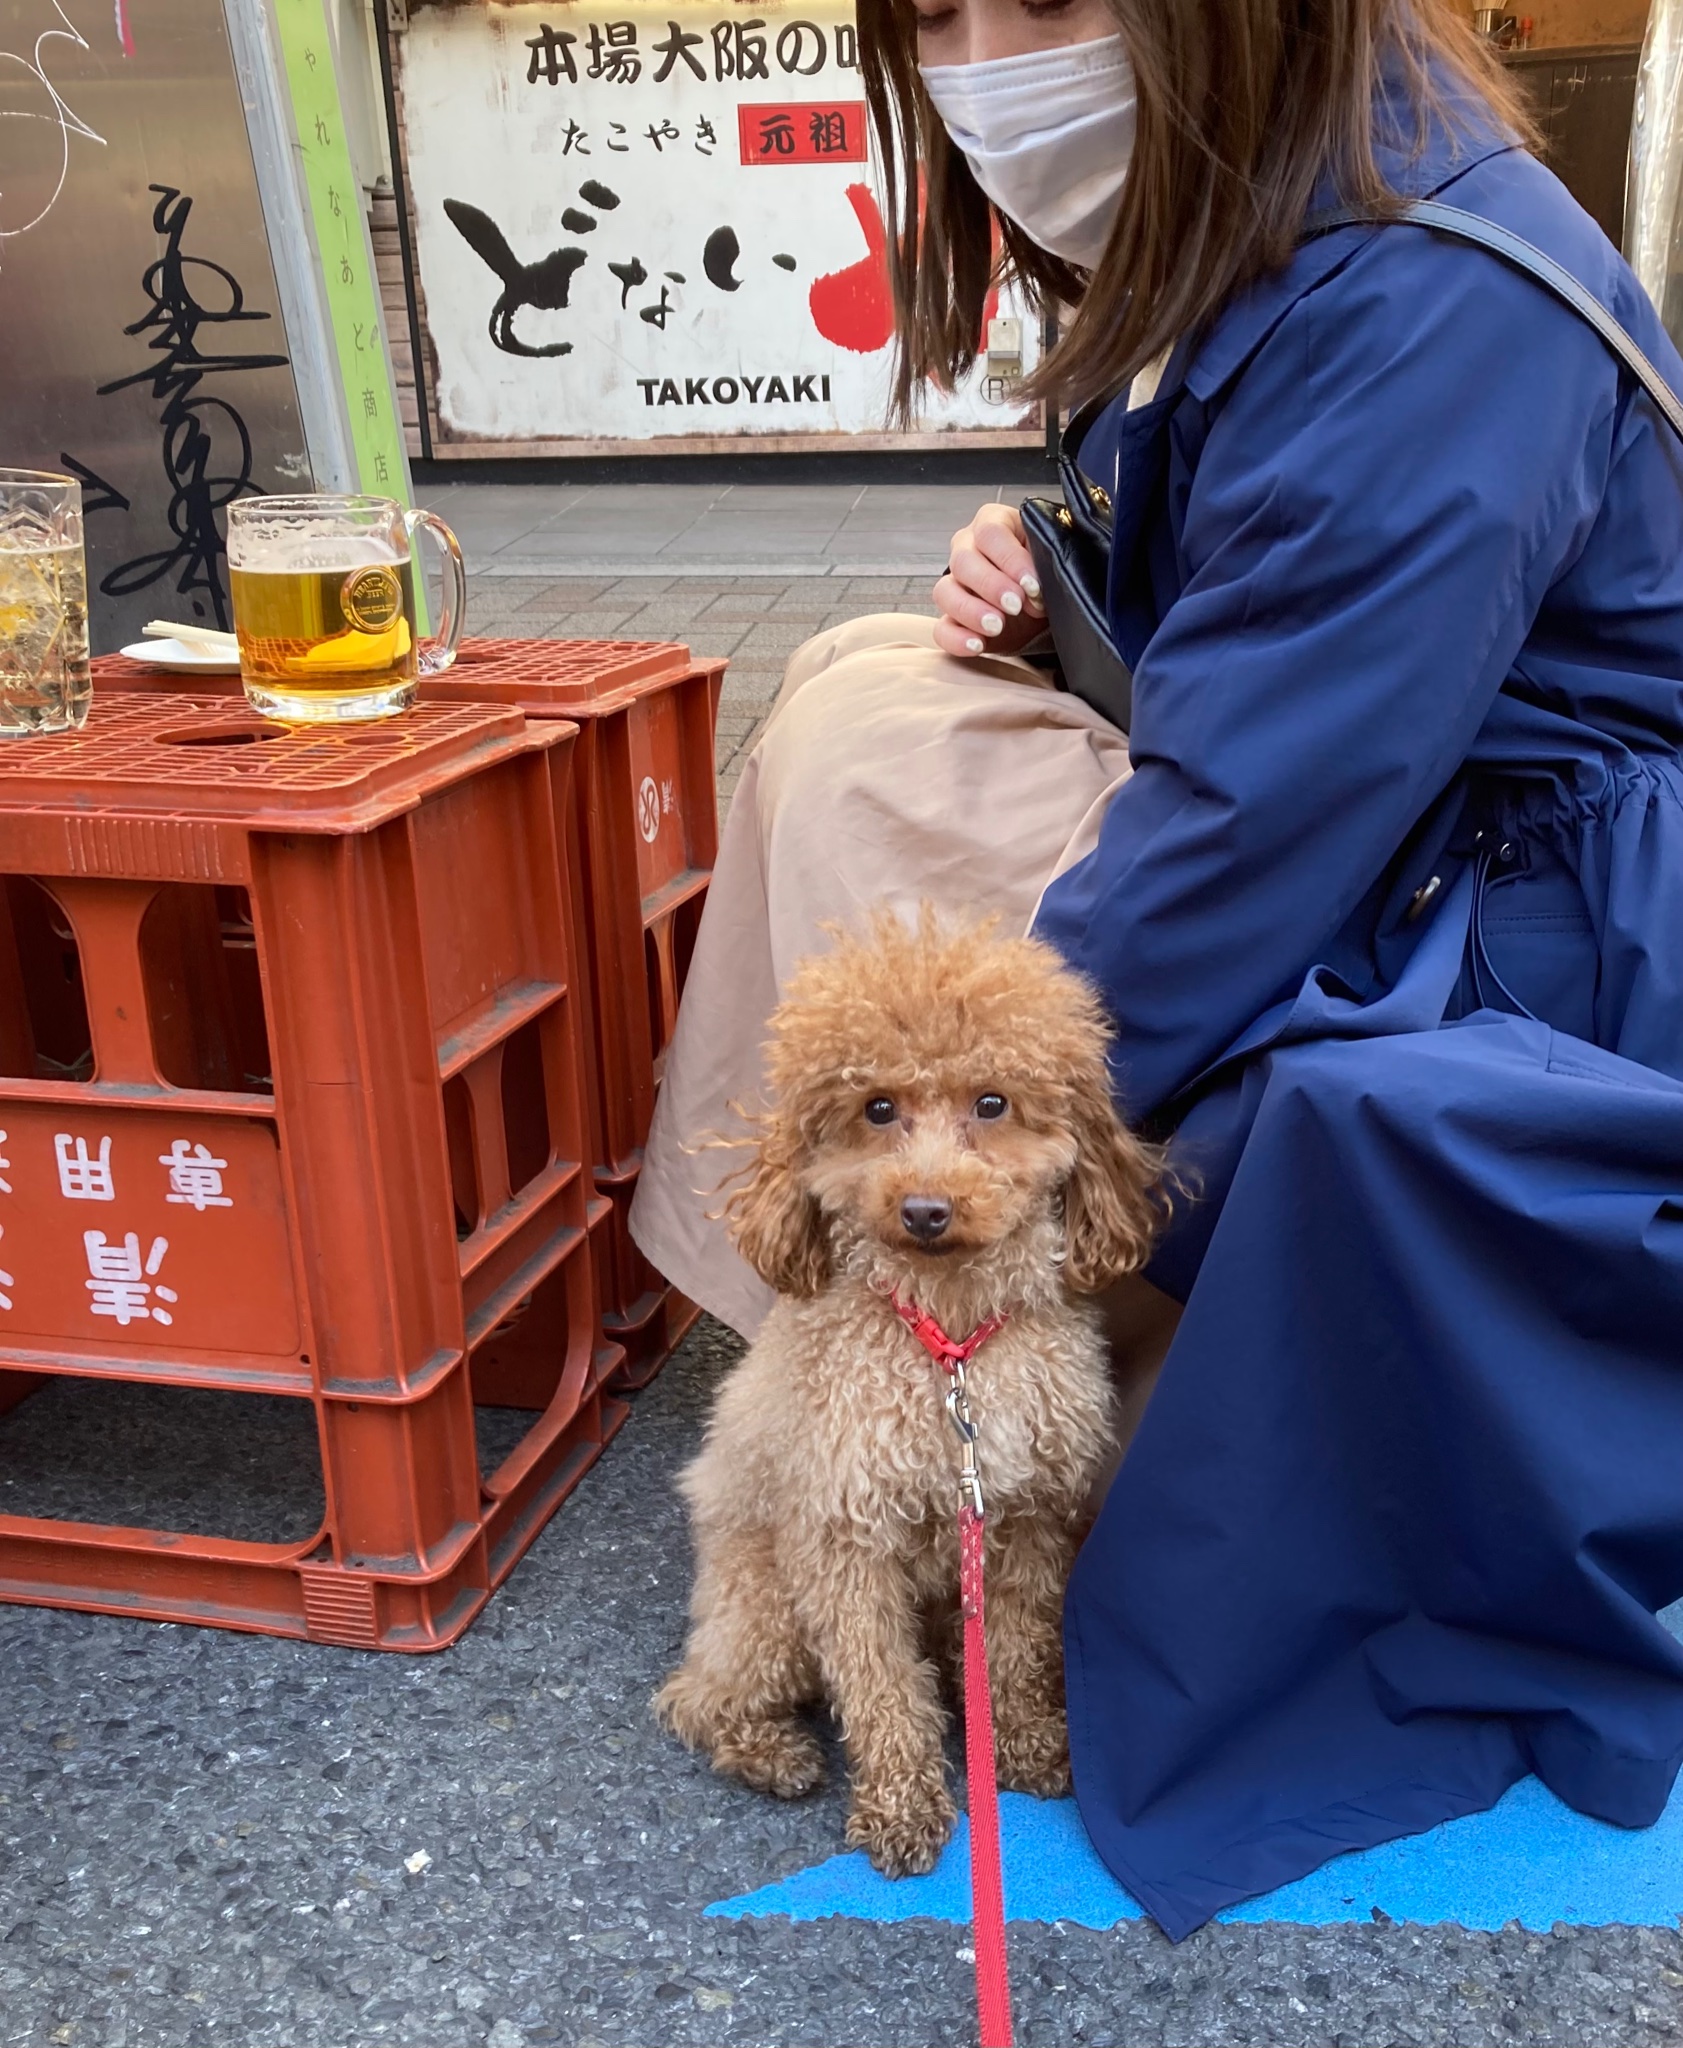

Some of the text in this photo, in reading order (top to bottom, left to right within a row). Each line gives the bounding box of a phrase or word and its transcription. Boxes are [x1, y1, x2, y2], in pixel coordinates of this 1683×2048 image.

[560, 113, 718, 156] たこやき
[759, 111, 848, 154] 元祖
[637, 373, 831, 406] TAKOYAKI
[0, 1129, 234, 1211] 専用
